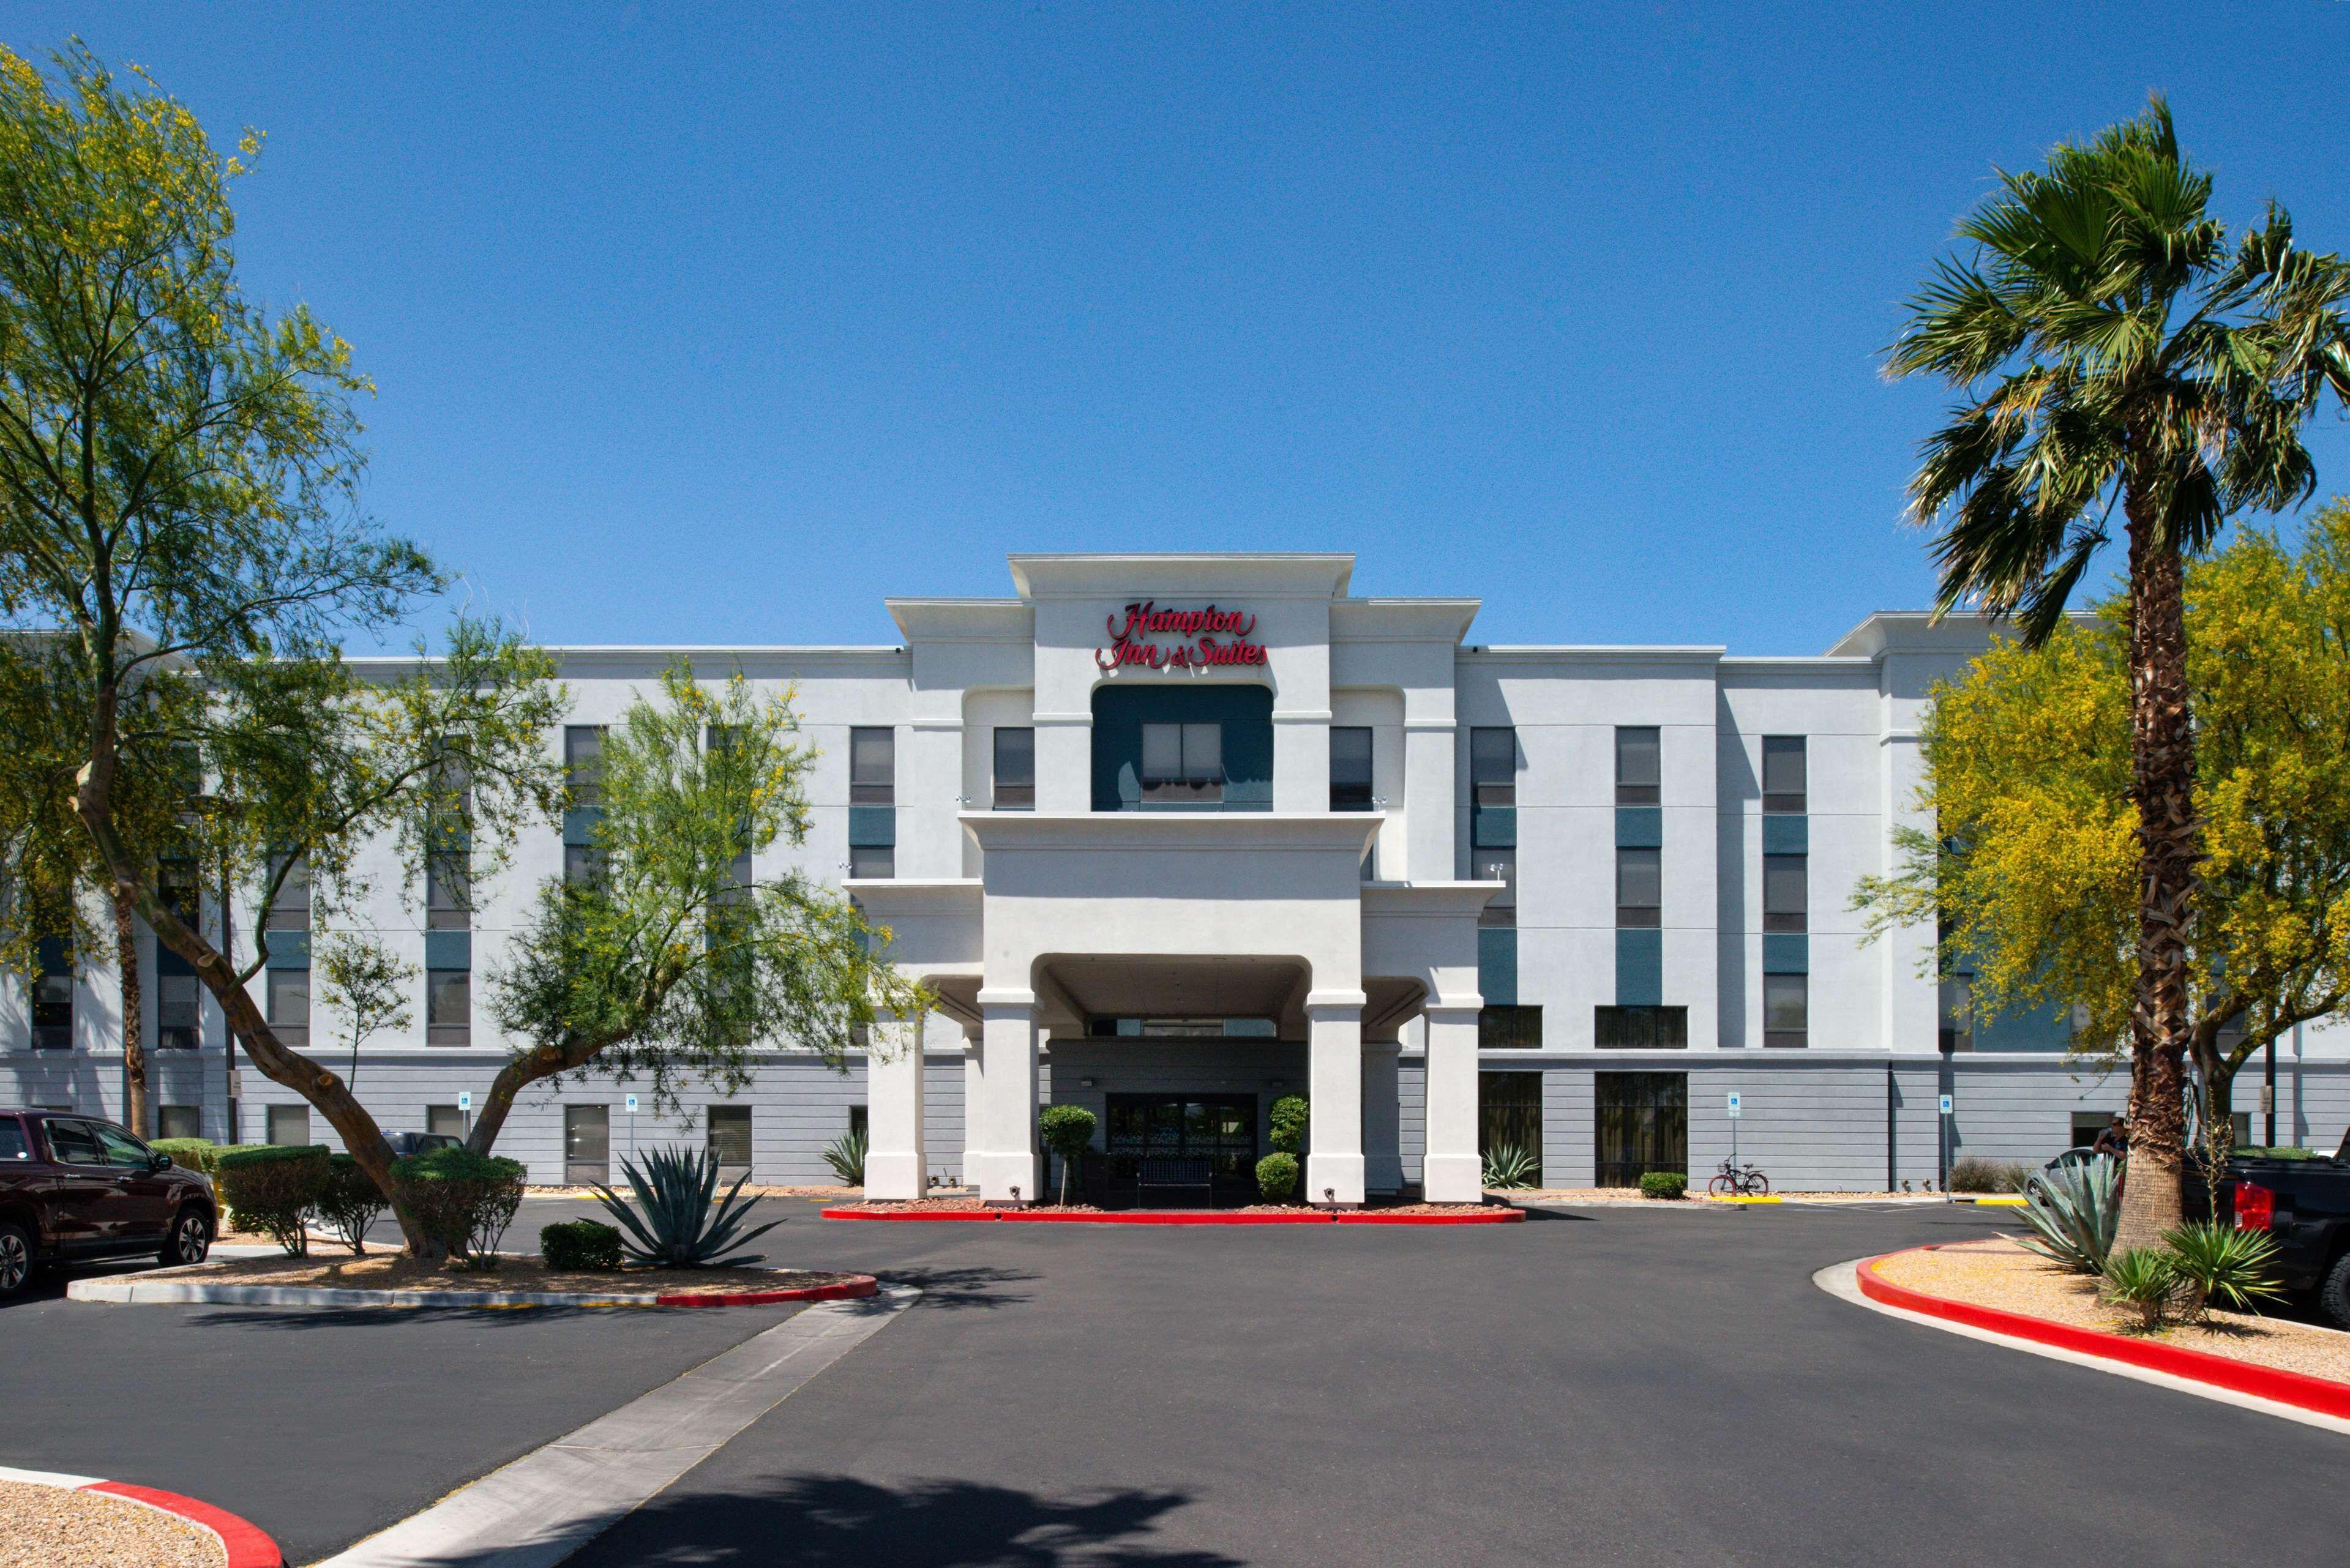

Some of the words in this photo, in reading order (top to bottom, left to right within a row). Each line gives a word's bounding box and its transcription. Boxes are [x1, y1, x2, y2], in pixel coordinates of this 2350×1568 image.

[1107, 601, 1255, 640] Hampton
[1096, 638, 1170, 670] Inn
[1171, 645, 1190, 668] &
[1188, 637, 1268, 666] Suites
